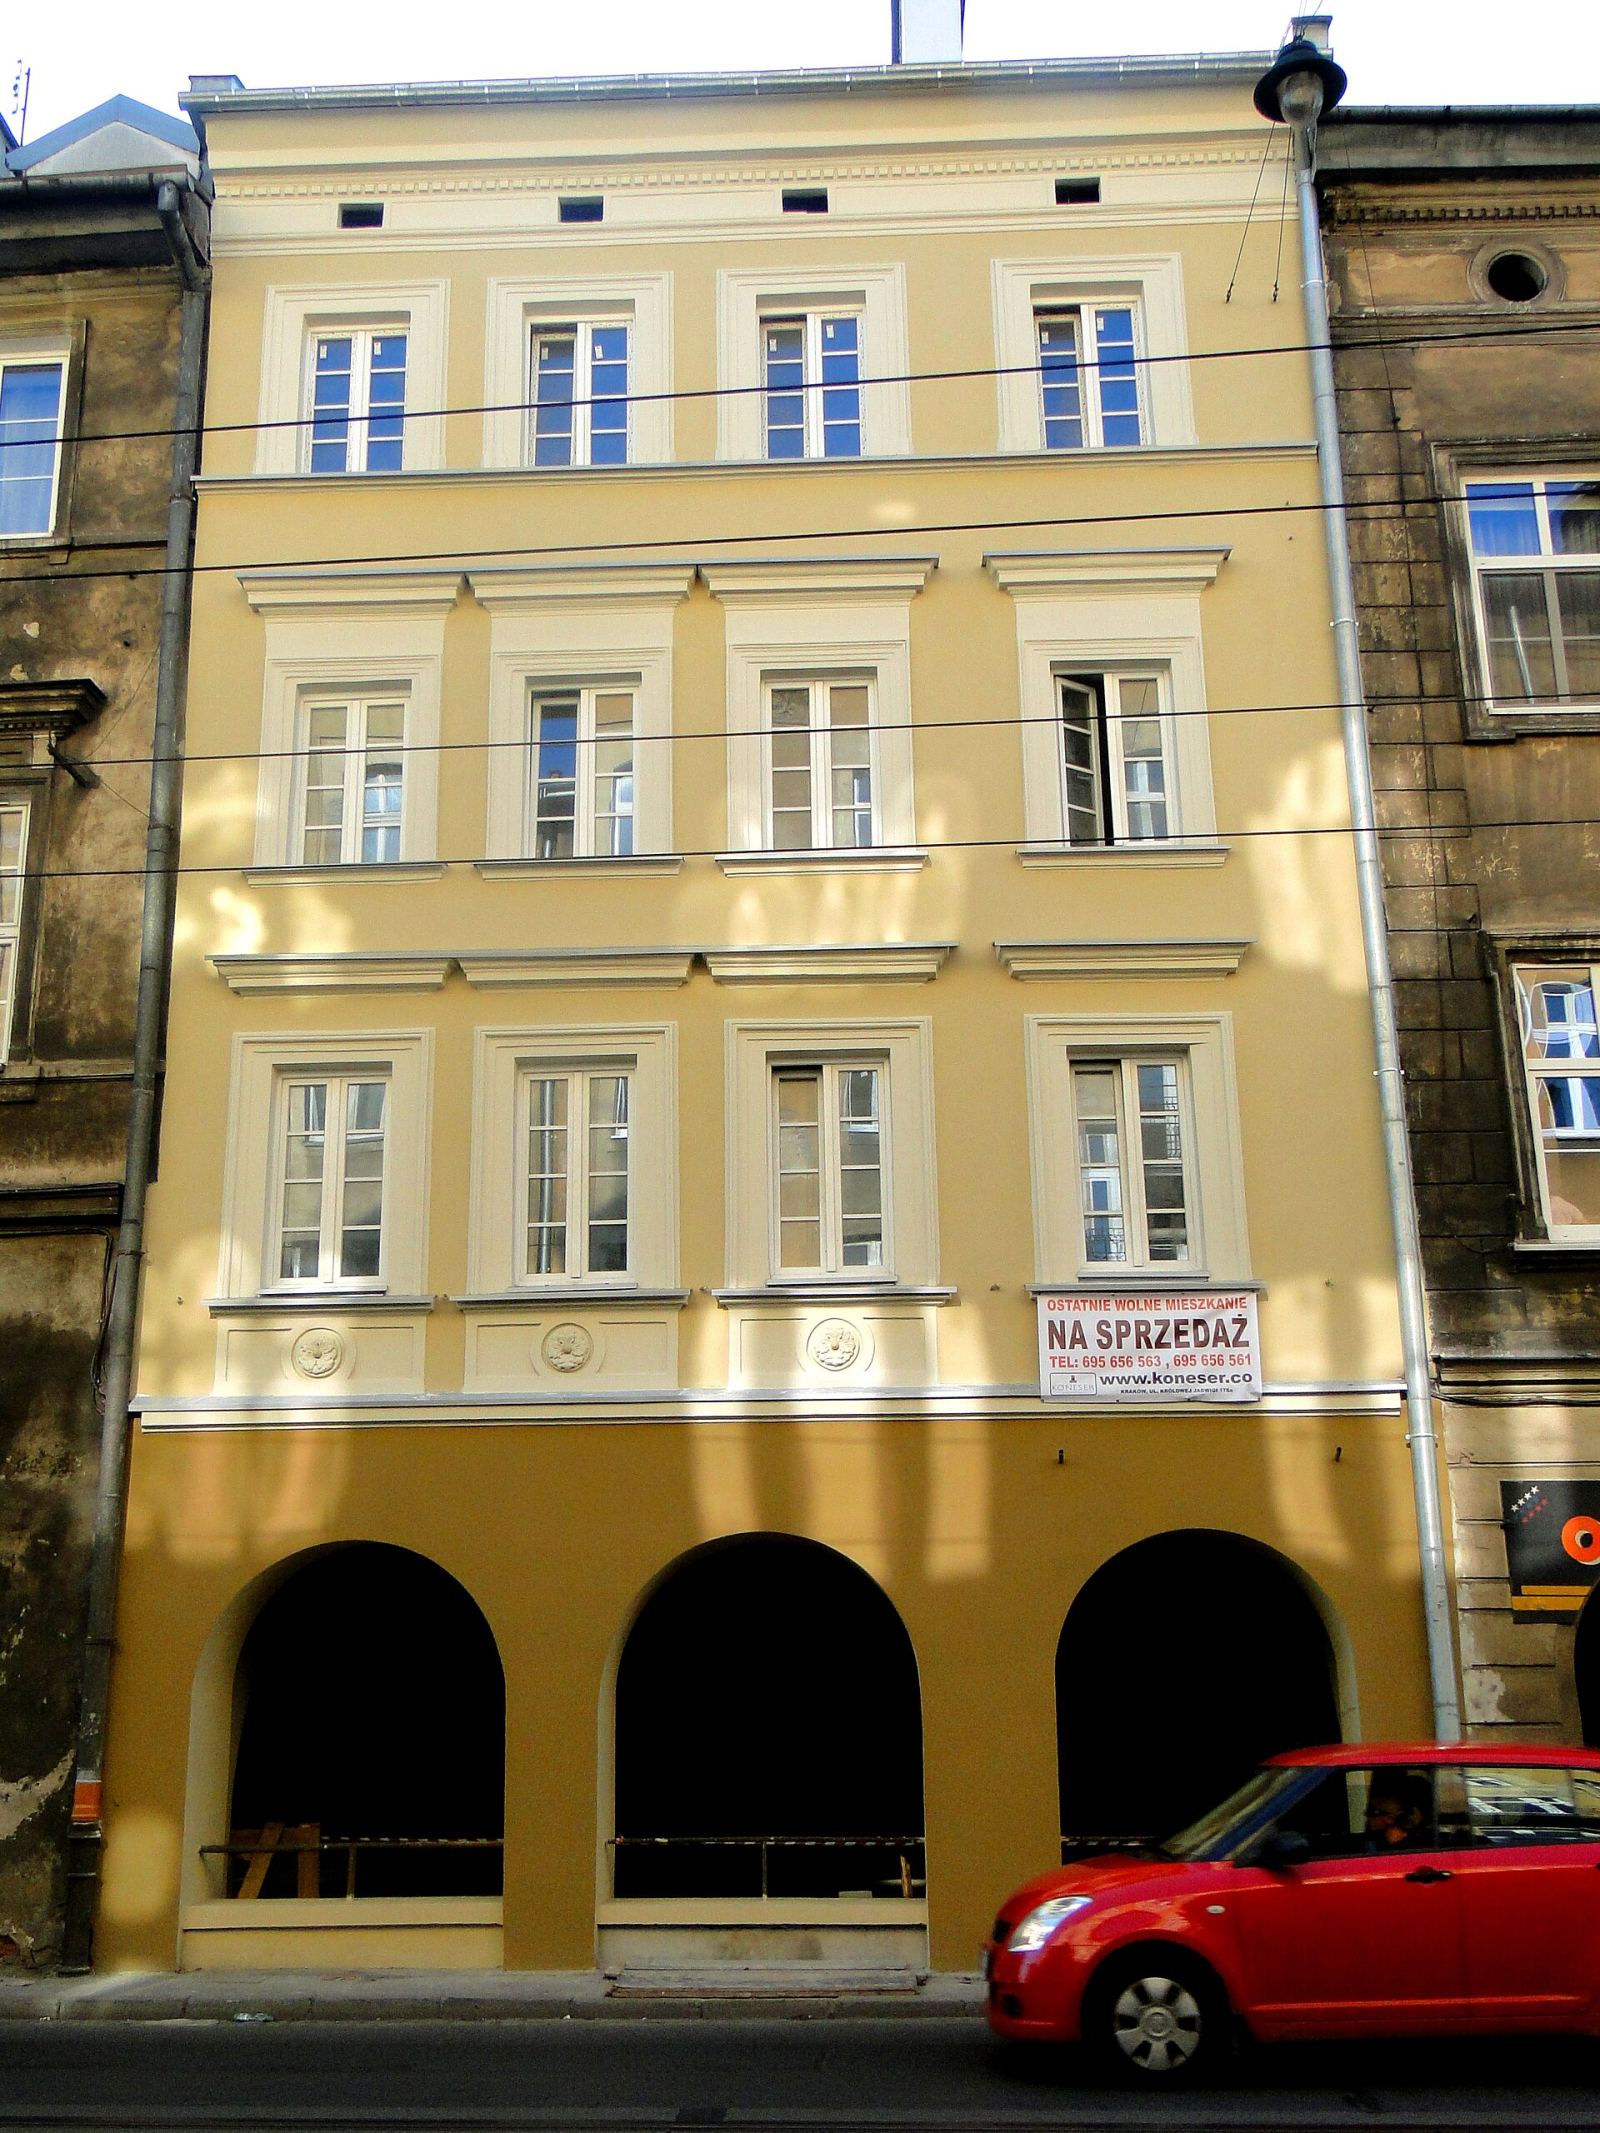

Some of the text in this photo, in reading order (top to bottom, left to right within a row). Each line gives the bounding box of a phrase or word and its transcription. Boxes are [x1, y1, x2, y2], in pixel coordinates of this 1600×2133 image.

[1047, 1297, 1247, 1312] OSTATNIE WOLNE MIESZKANIE
[1048, 1314, 1250, 1350] NA SPRZEDAŻ
[1049, 1356, 1079, 1368] TEL:
[1082, 1355, 1105, 1368] 695
[1109, 1355, 1133, 1368] 656
[1138, 1355, 1161, 1368] 563
[1173, 1354, 1197, 1367] 695
[1201, 1354, 1225, 1367] 656
[1229, 1353, 1251, 1366] 561
[1099, 1372, 1253, 1386] www.koneser.co
